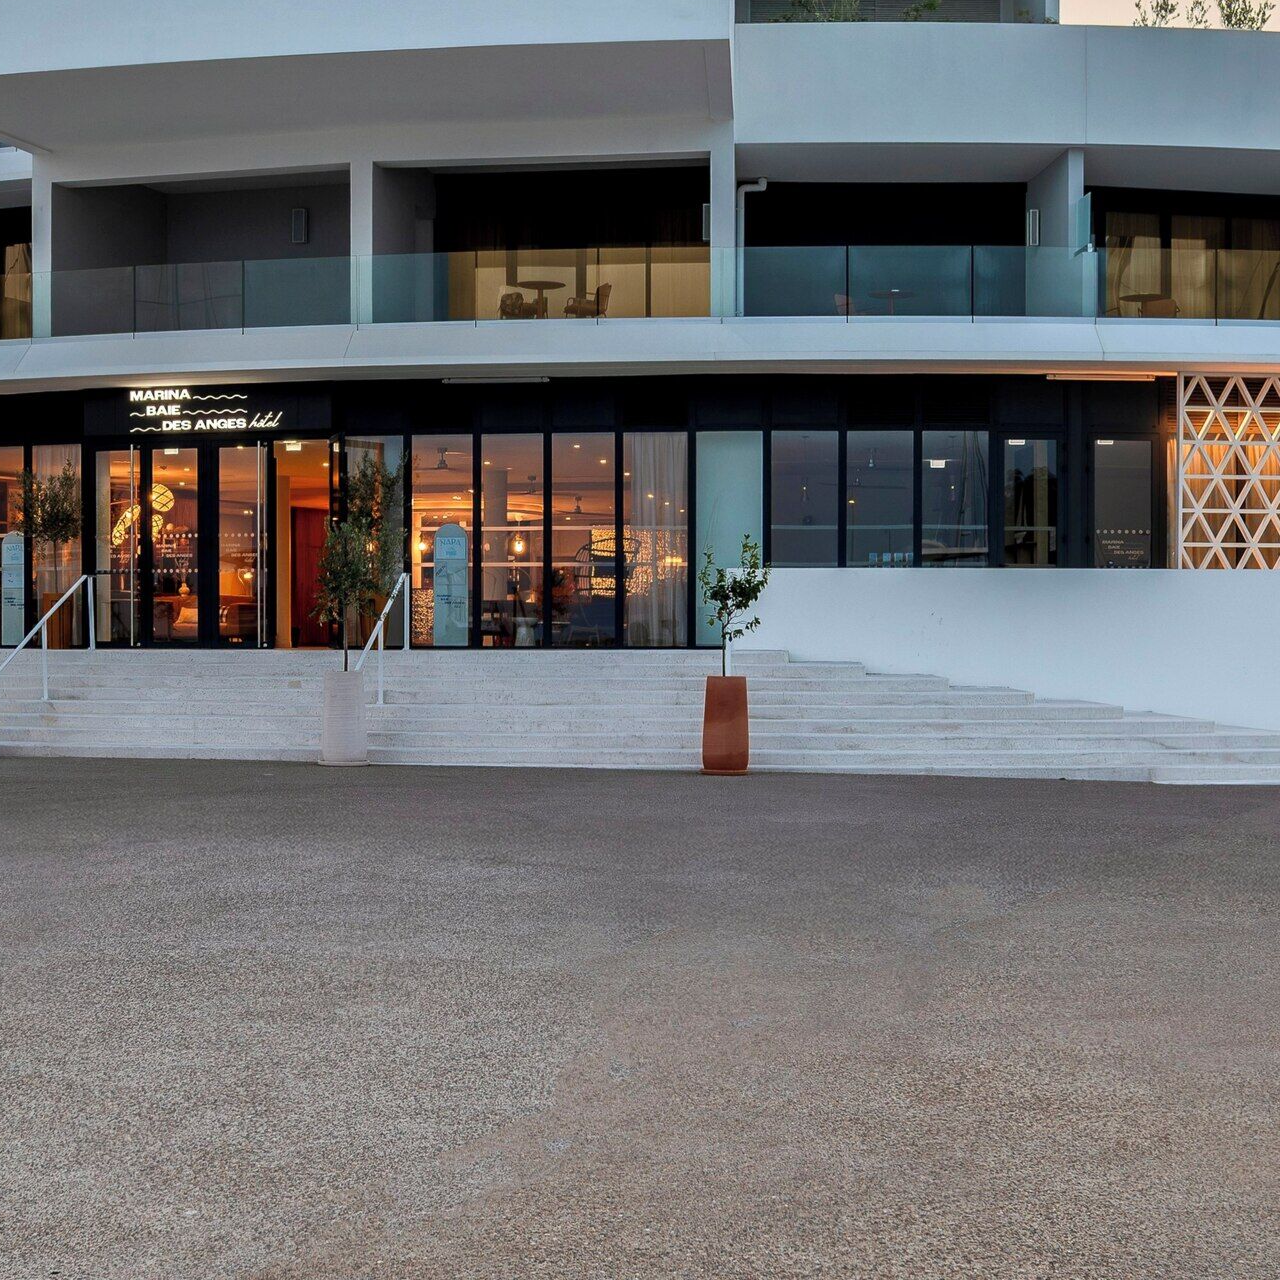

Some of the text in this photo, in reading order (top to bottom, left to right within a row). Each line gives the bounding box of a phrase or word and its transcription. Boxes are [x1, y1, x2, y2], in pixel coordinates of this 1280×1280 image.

[130, 389, 191, 402] MARINA
[146, 405, 181, 417] BAIE
[162, 411, 283, 431] DES ANGES hôtel
